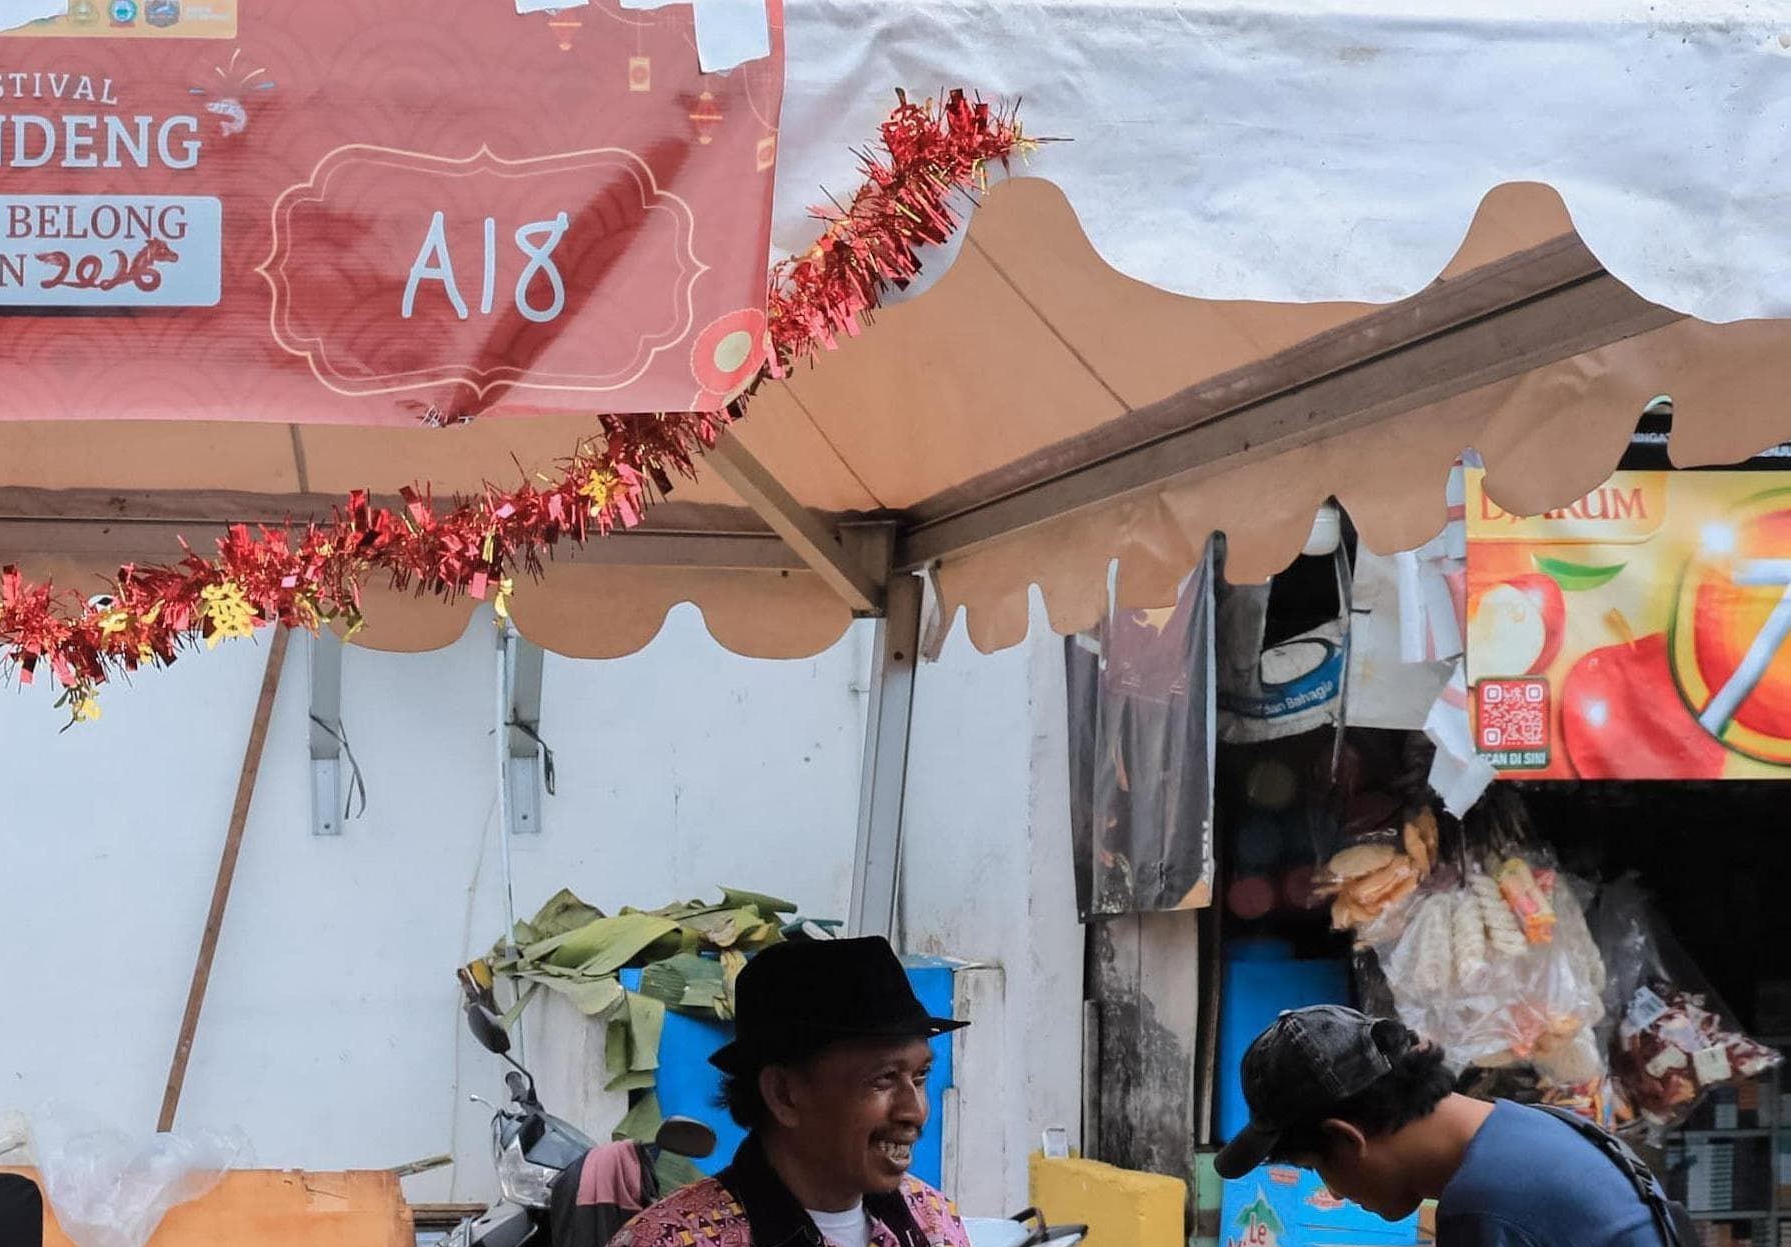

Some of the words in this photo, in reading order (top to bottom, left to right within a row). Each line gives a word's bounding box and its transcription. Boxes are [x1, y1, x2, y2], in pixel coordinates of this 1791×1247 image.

[6, 203, 188, 240] BELONG
[34, 236, 180, 293] 2026
[401, 211, 570, 323] A18
[1249, 1213, 1267, 1246] Le
